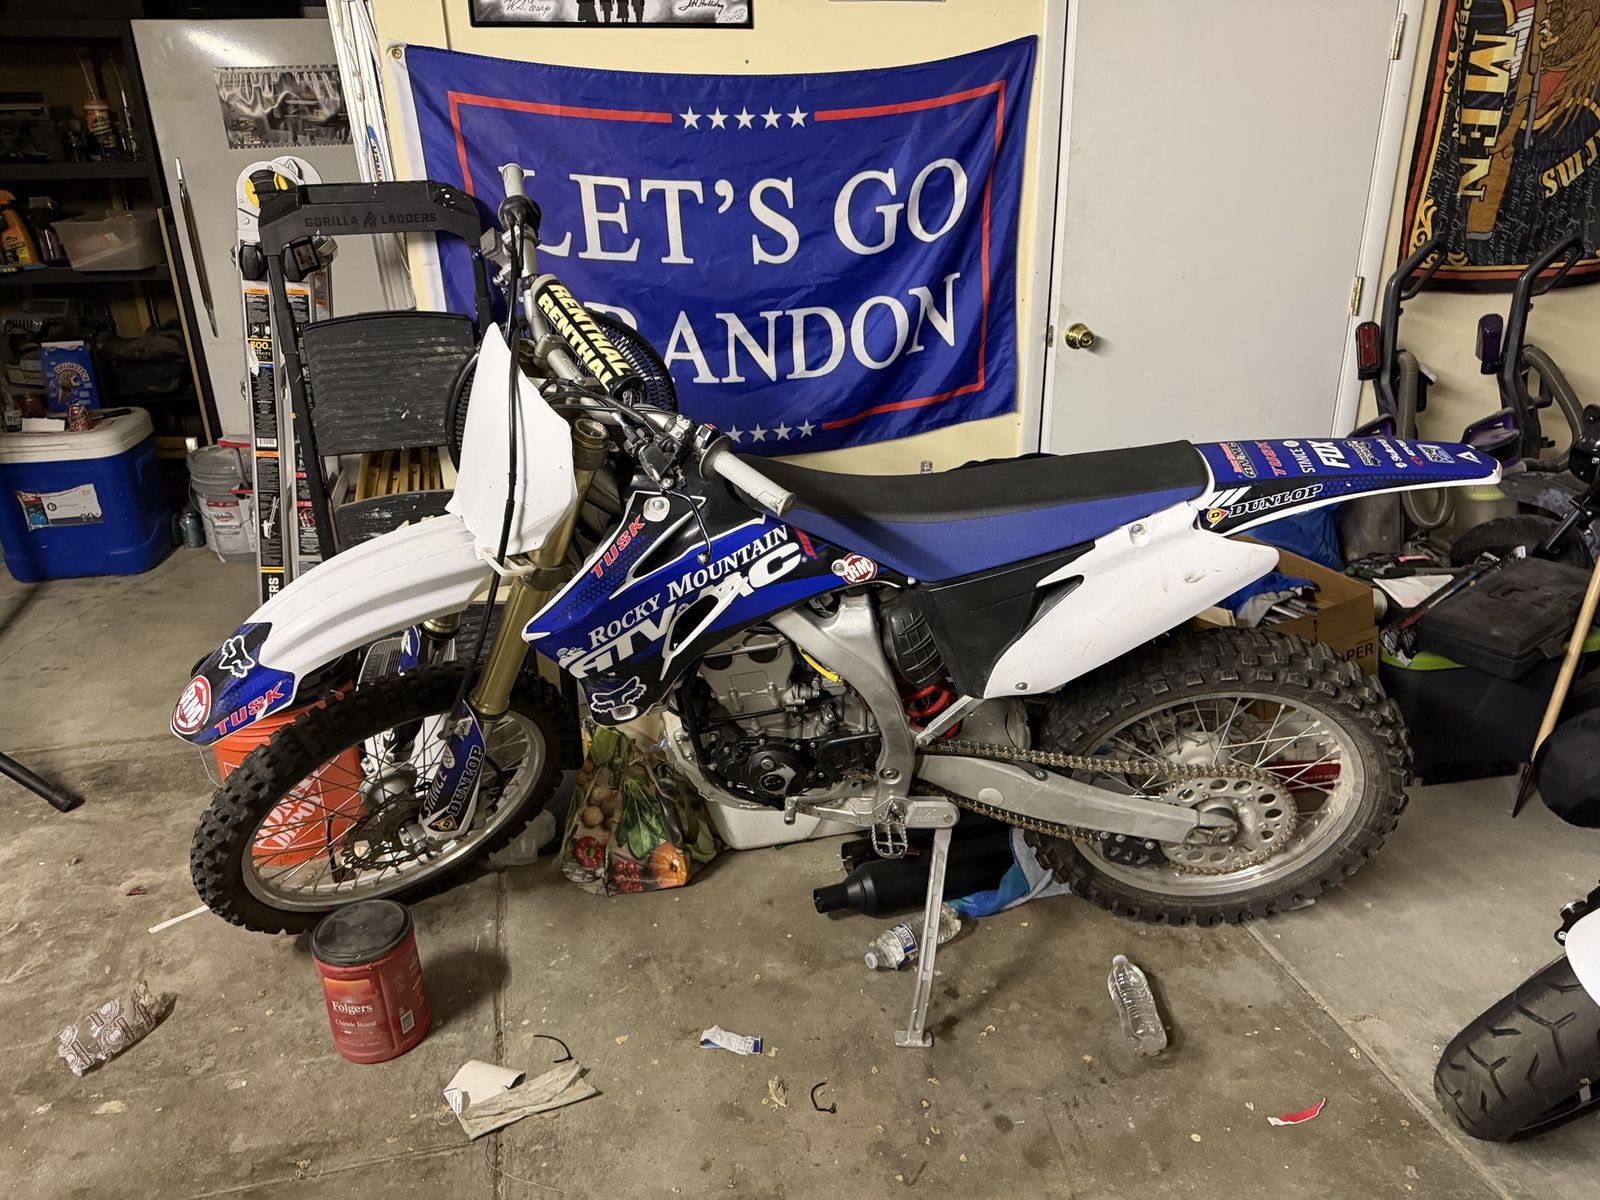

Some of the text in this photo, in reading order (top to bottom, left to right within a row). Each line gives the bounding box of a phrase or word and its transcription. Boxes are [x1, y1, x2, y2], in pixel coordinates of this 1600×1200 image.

[1458, 29, 1517, 201] MEN
[1541, 134, 1600, 198] rms
[304, 212, 438, 228] GORILLA LADDERS
[834, 158, 968, 256] GO
[537, 292, 614, 392] RENTHAL
[547, 284, 634, 377] RENTHAL
[584, 273, 961, 387] ANDON
[1289, 447, 1316, 473] STANCE
[1306, 439, 1351, 469] FOX
[1228, 483, 1323, 518] DUNLOP
[590, 514, 646, 579] TUSK
[588, 593, 661, 650] ROCKY
[666, 524, 788, 604] MOUNTAIN
[1341, 642, 1374, 662] PER
[214, 680, 286, 736] TUSK
[445, 744, 485, 817] DUNLOP
[331, 1000, 373, 1015] Folgers
[335, 1018, 377, 1028] Classic Roast
